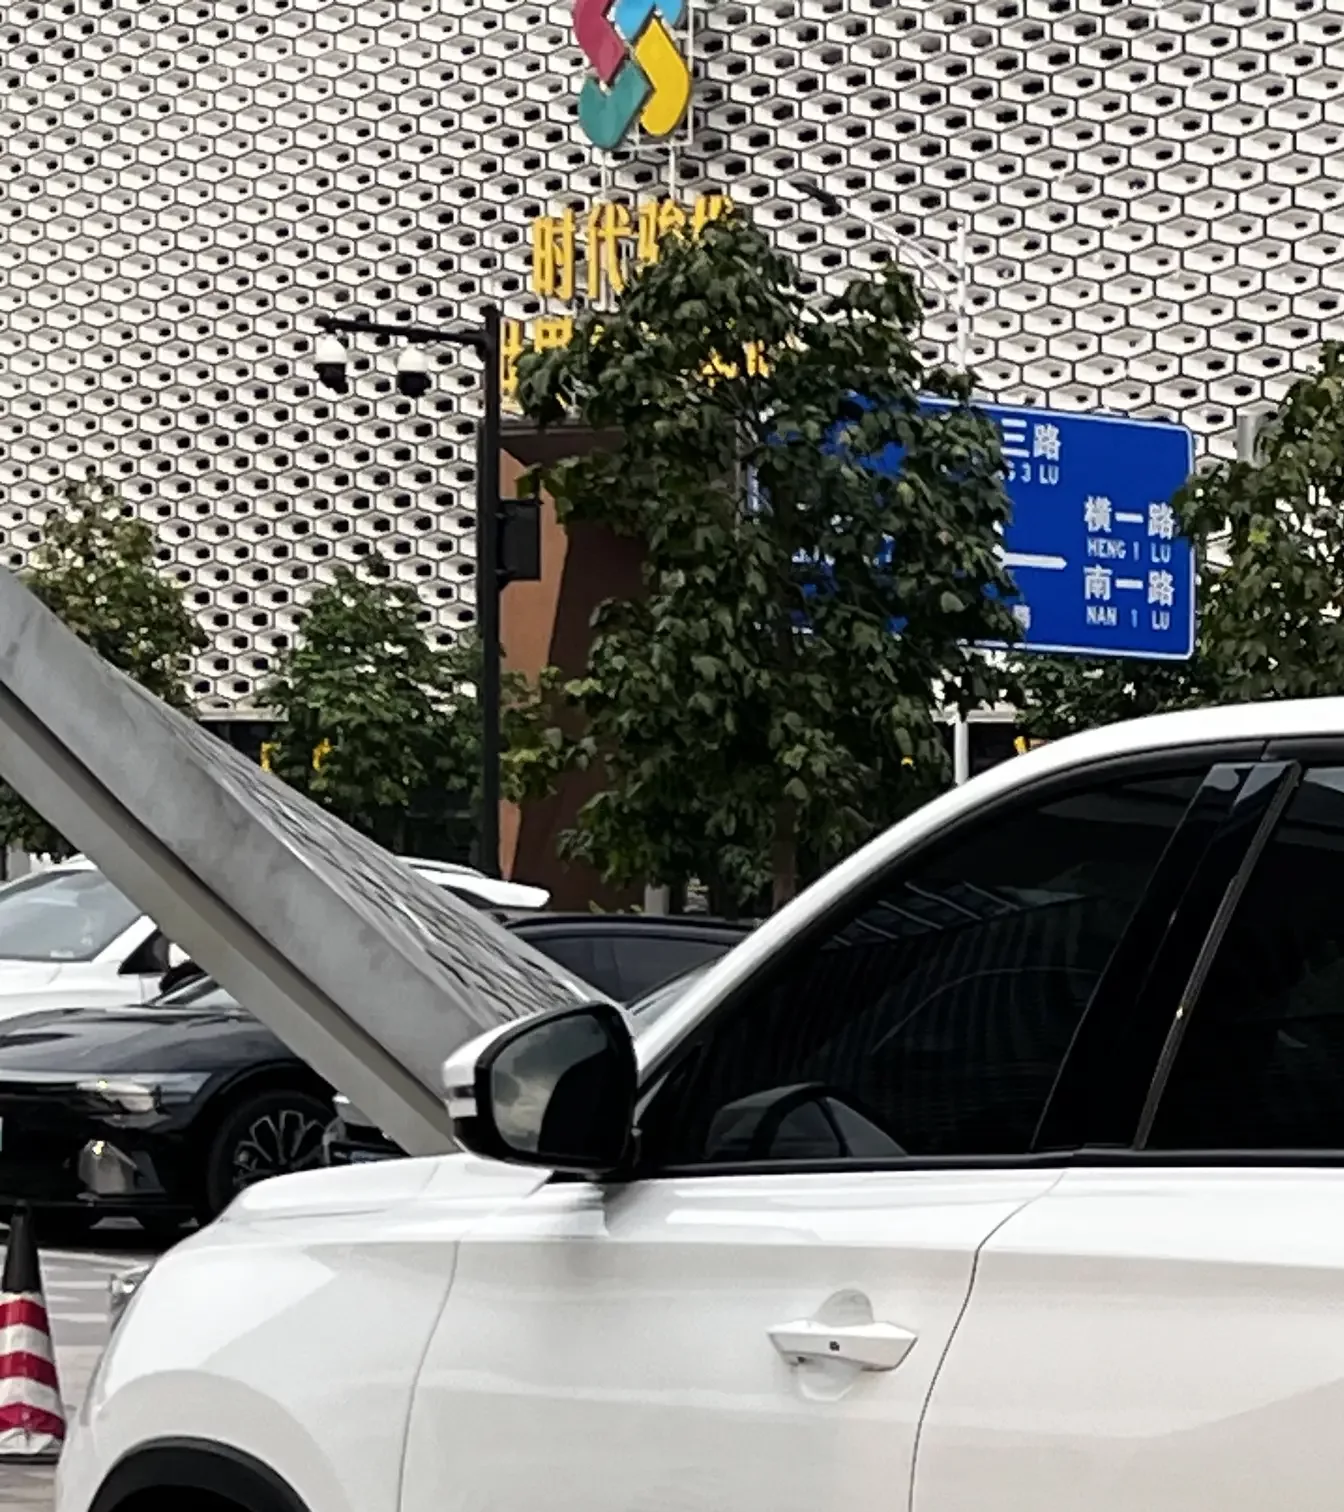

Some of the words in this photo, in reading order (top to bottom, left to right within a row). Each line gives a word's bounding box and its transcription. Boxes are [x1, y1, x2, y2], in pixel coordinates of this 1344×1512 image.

[1039, 464, 1060, 486] LU
[1083, 495, 1176, 540] 横一路
[1087, 536, 1127, 560] HENG
[1151, 542, 1172, 564] LU
[1083, 563, 1176, 607] 南一路
[1086, 605, 1118, 627] NAN
[1151, 610, 1171, 631] LU
